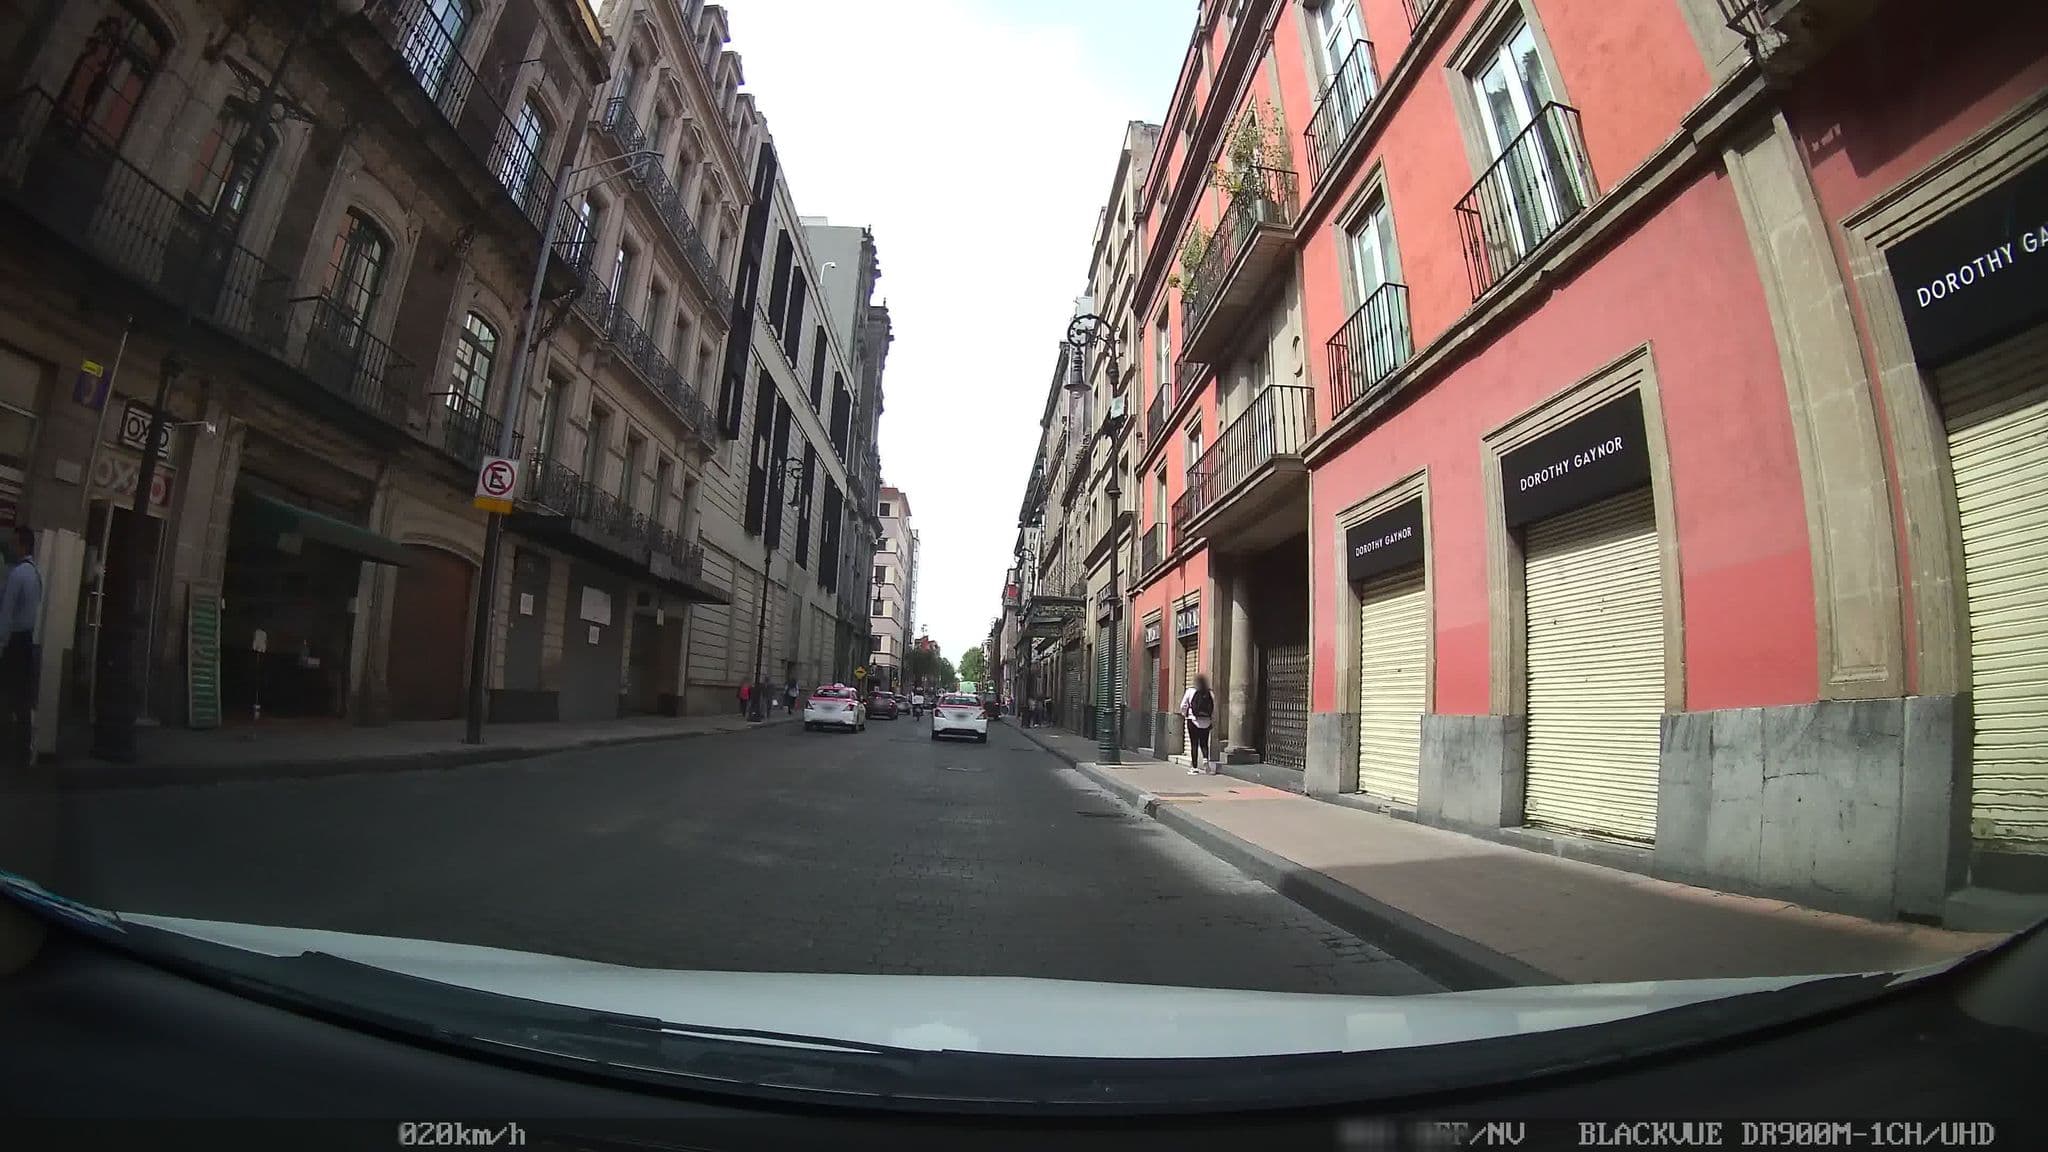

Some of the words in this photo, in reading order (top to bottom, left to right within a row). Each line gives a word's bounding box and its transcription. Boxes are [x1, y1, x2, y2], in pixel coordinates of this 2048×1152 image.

[1917, 243, 2013, 308] DOROTHY
[128, 417, 169, 448] OXO
[489, 467, 507, 489] E
[1520, 460, 1570, 492] DOROTHY
[1574, 436, 1623, 469] GAYNOR
[1355, 537, 1383, 557] DOROTHY
[1384, 526, 1412, 546] GAYNOR
